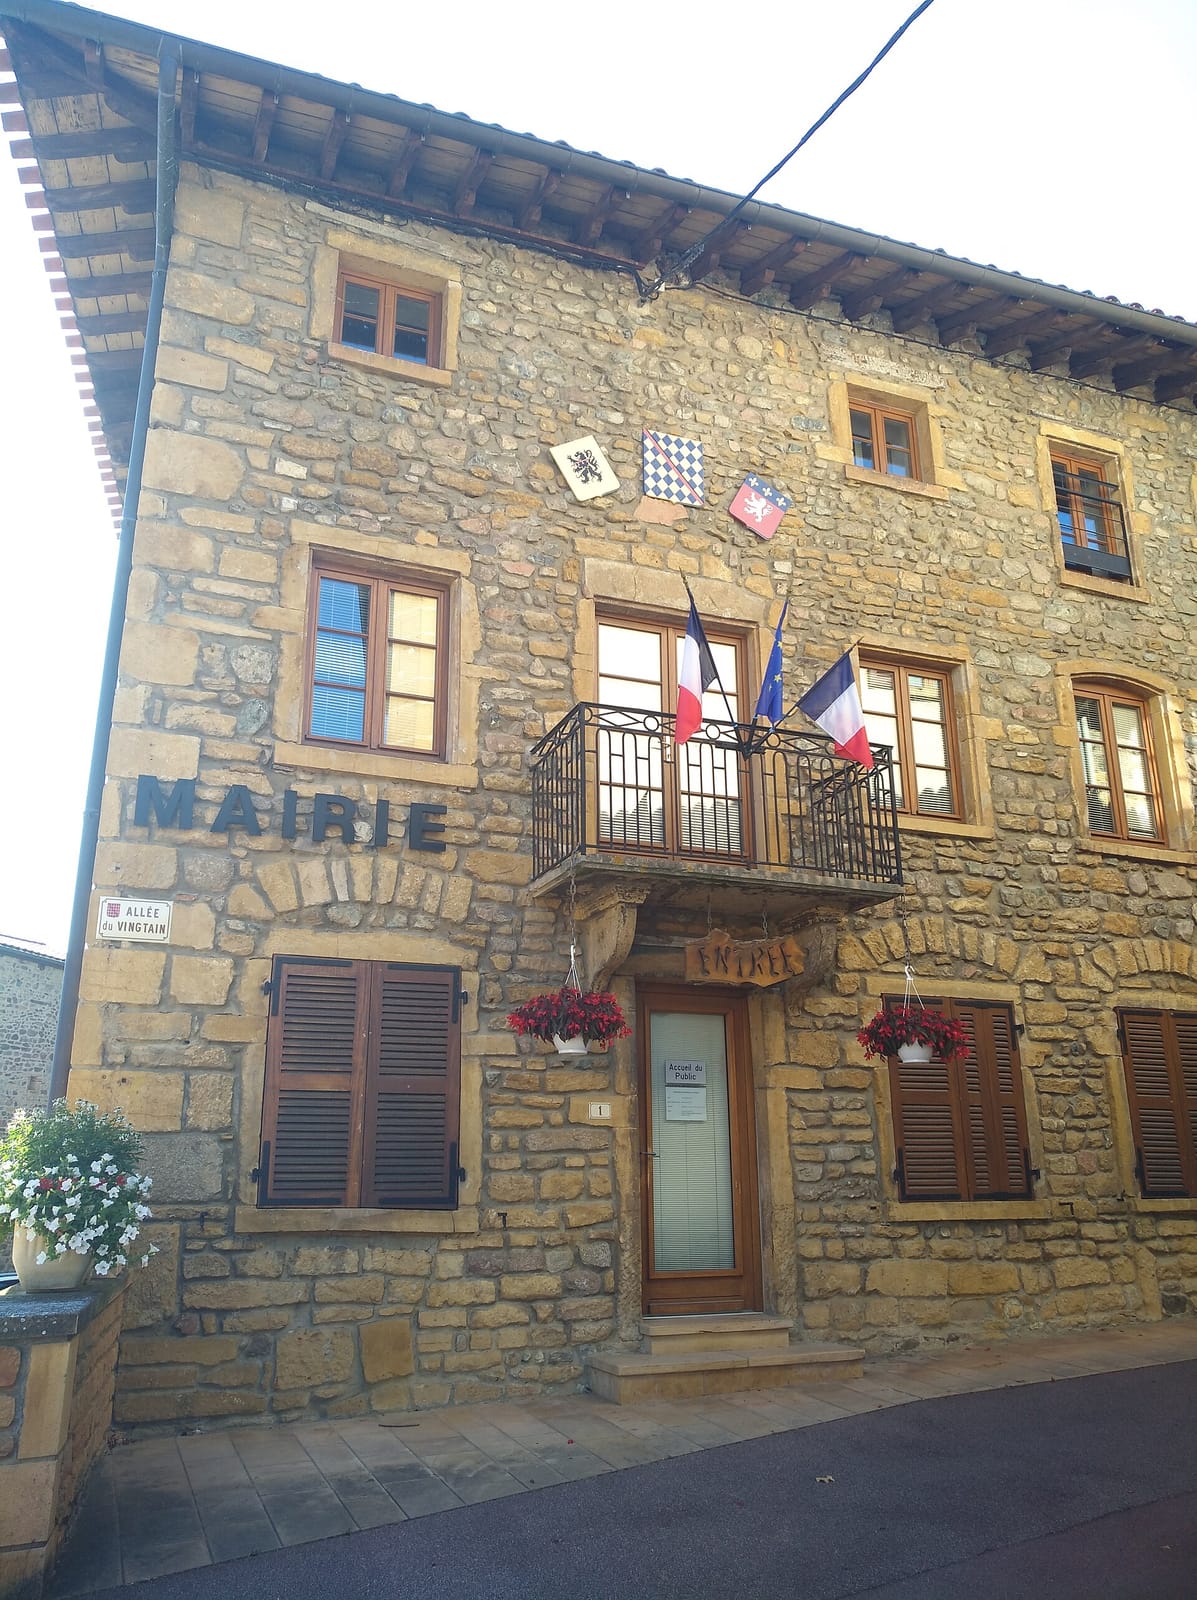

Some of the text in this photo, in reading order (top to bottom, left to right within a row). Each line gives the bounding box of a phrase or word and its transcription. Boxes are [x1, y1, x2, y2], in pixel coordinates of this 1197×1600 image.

[134, 774, 447, 850] MAIRIE
[126, 906, 160, 918] ALLÉE
[102, 921, 166, 934] du VINGTAIN
[669, 1063, 692, 1071] Accueil
[675, 1072, 697, 1080] Public
